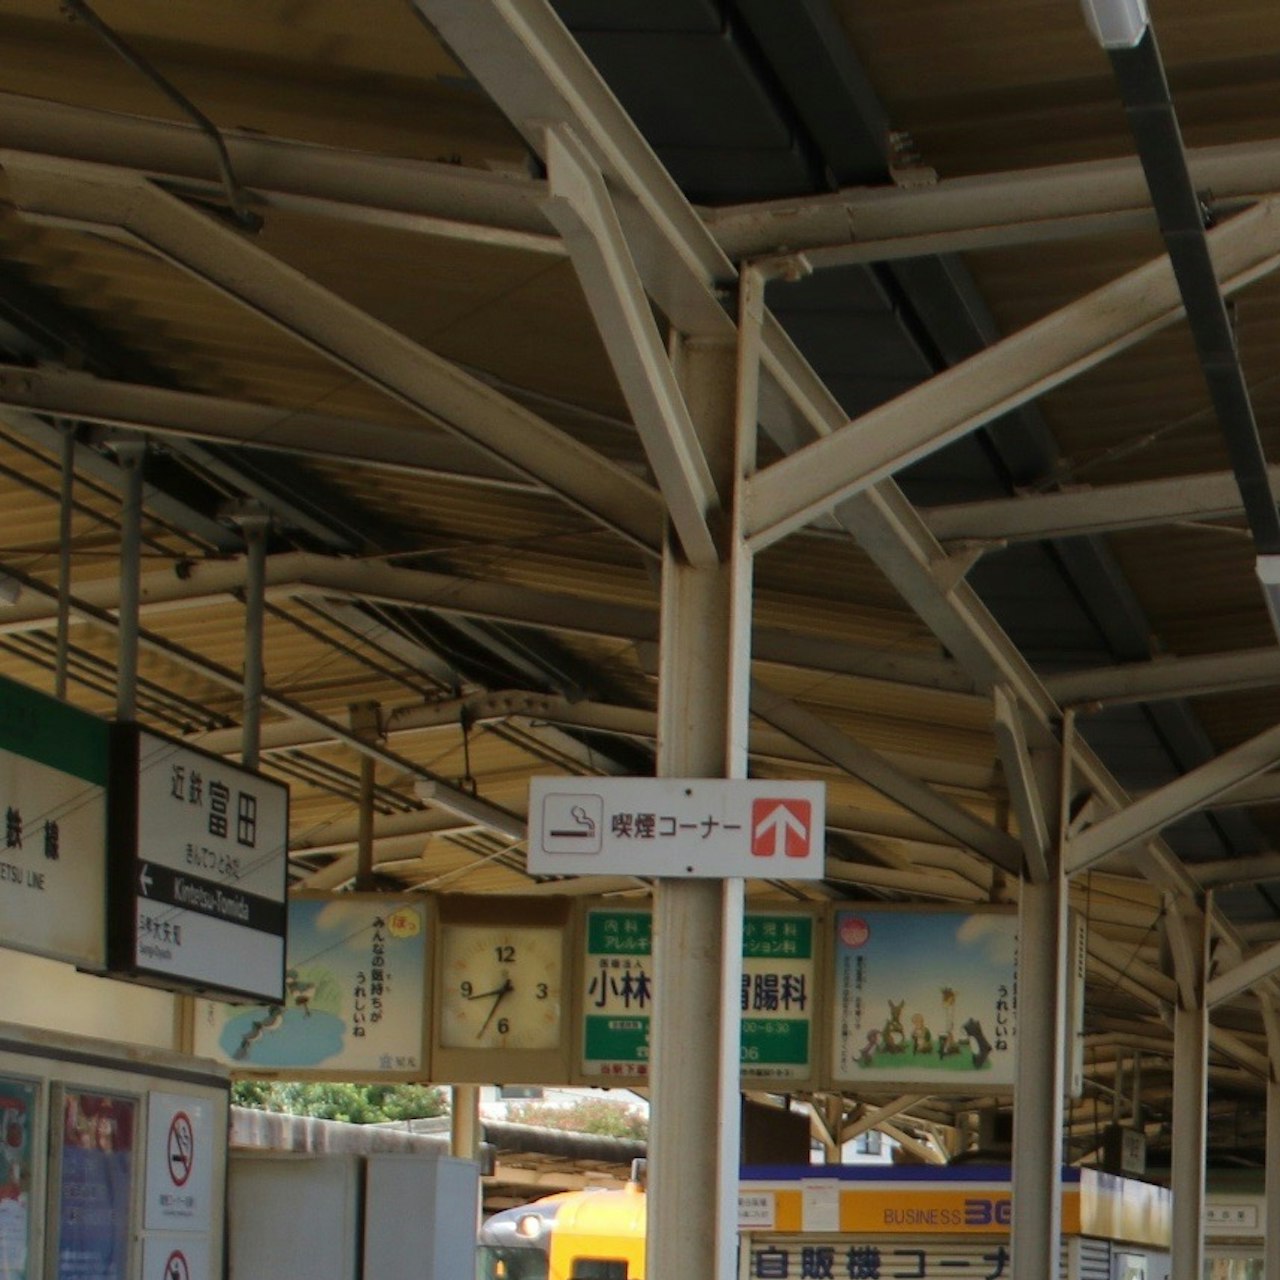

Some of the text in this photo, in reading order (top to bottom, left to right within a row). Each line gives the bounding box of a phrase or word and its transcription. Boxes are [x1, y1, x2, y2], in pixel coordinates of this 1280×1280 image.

[171, 763, 257, 848] 近鉄富田
[611, 812, 743, 840] 喫煙コーナー
[27, 868, 46, 890] LINE
[605, 935, 651, 950] アレルギ
[494, 945, 516, 963] 12
[460, 980, 473, 998] 9
[536, 983, 548, 1000] 3
[588, 970, 651, 1009] 小林
[352, 970, 367, 1038] うれしいね
[497, 1017, 510, 1034] 6
[995, 984, 1008, 1051] うれしいね
[883, 1208, 962, 1225] BUSINESS
